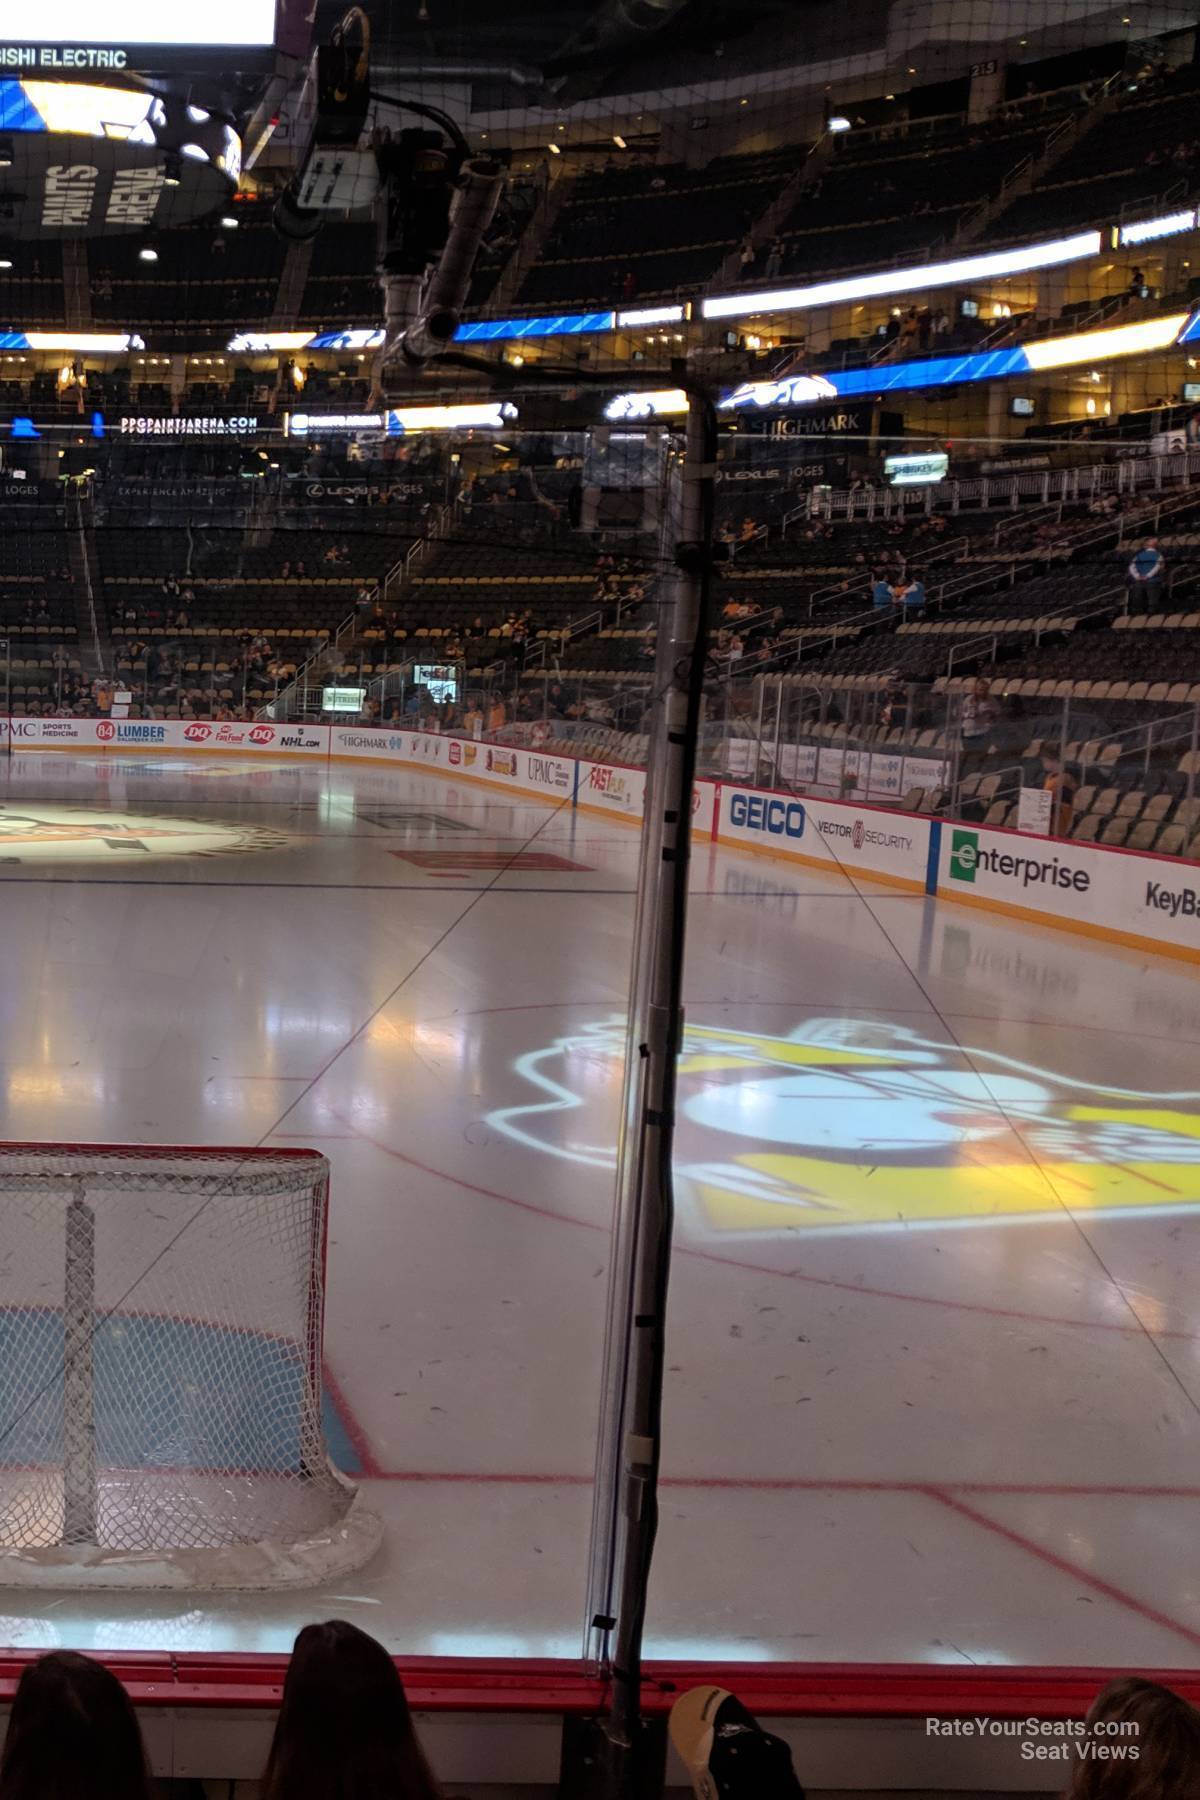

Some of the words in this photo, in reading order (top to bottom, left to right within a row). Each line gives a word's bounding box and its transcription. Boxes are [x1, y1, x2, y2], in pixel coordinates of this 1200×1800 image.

[40, 48, 128, 68] ELECTRIC
[41, 164, 99, 227] PAINTS
[104, 164, 167, 226] ARENA
[762, 413, 859, 435] HIGHMARK
[725, 470, 780, 481] LEXUS
[5, 485, 39, 496] LOGES
[97, 725, 114, 738] 84
[117, 724, 165, 738] LUMBER
[188, 725, 209, 739] DQ
[254, 726, 273, 740] DQ
[280, 737, 320, 748] NHL.COM
[343, 734, 387, 749] HIGHMARK
[528, 757, 555, 785] UPMC
[730, 793, 806, 839] GEICO
[818, 820, 852, 839] VECTOR
[865, 829, 913, 851] SECURITY
[951, 842, 1091, 892] enterprise
